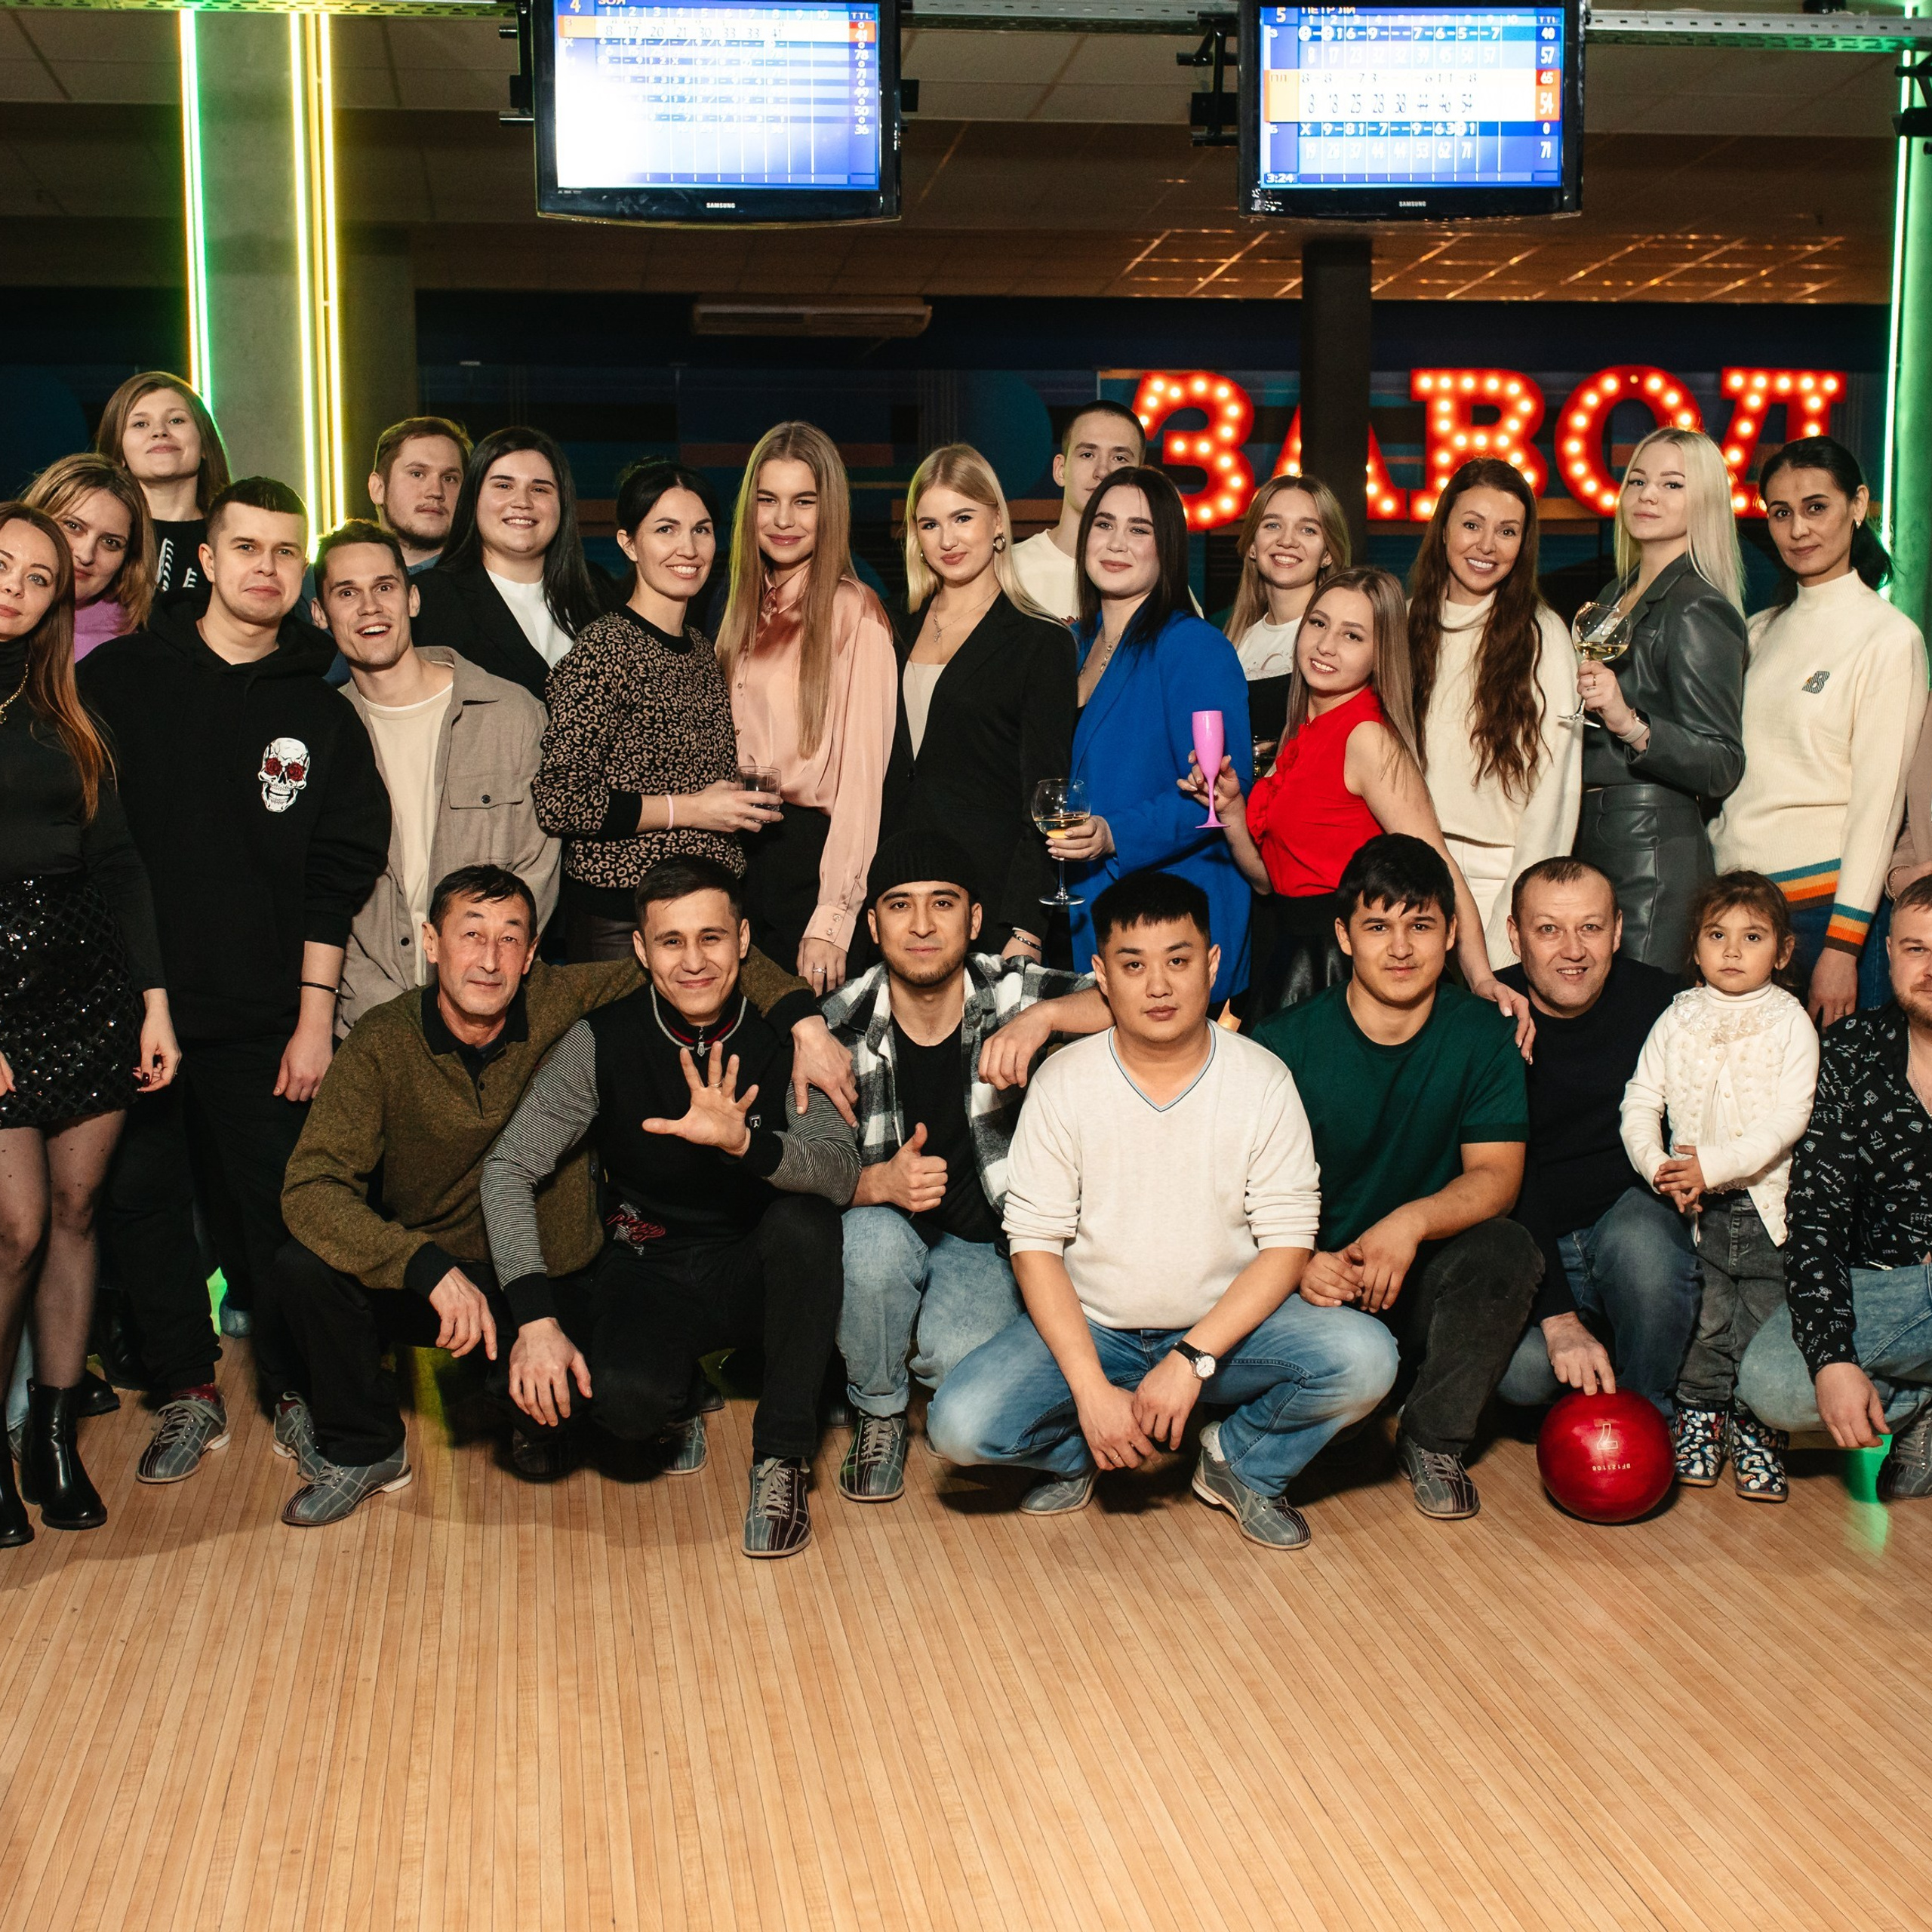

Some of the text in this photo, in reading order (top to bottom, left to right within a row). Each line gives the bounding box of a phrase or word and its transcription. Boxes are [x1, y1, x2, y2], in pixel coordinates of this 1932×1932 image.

[570, 0, 581, 13] 4
[605, 7, 611, 16] 1
[629, 7, 637, 17] 2
[653, 7, 661, 17] 3
[676, 8, 685, 17] 4
[701, 8, 709, 17] 5
[724, 9, 732, 19] 6
[748, 9, 755, 19] 7
[771, 9, 780, 20] 8
[795, 9, 804, 20] 9
[817, 10, 829, 20] 10
[1275, 7, 1286, 23] 5
[1309, 15, 1314, 25] 1
[1330, 15, 1338, 25] 2
[1353, 15, 1361, 25] 3
[1375, 15, 1383, 25] 4
[1398, 15, 1404, 25] 5
[1442, 15, 1450, 25] 7
[1464, 15, 1472, 25] 8
[1486, 15, 1494, 25] 9
[1507, 15, 1518, 25] 10
[605, 26, 613, 36] 8
[629, 26, 638, 37] 17
[651, 26, 664, 38] 20
[676, 27, 687, 38] 21
[700, 27, 712, 38] 30
[724, 28, 736, 38] 33
[748, 28, 759, 38] 33
[855, 29, 868, 42] 41
[1541, 27, 1555, 40] 40
[854, 49, 869, 60] 78
[1540, 46, 1555, 64] 57
[856, 68, 868, 78] 71
[1540, 72, 1554, 84] 65
[854, 87, 869, 98] 49
[1309, 94, 1315, 113] 8
[1329, 94, 1338, 113] 18
[1350, 94, 1361, 113] 25
[1373, 94, 1384, 113] 28
[1395, 94, 1406, 113] 38
[1462, 94, 1472, 113] 54
[1540, 92, 1554, 115] 54
[854, 105, 869, 116] 50
[854, 125, 869, 135] 36
[1543, 122, 1551, 134] 0
[1437, 141, 1452, 159] 62
[1461, 141, 1472, 159] 71
[1540, 141, 1552, 158] 71
[1266, 174, 1295, 183] 3:24
[1890, 1147, 1912, 1163] REBEL
[1596, 1423, 1619, 1451] 7
